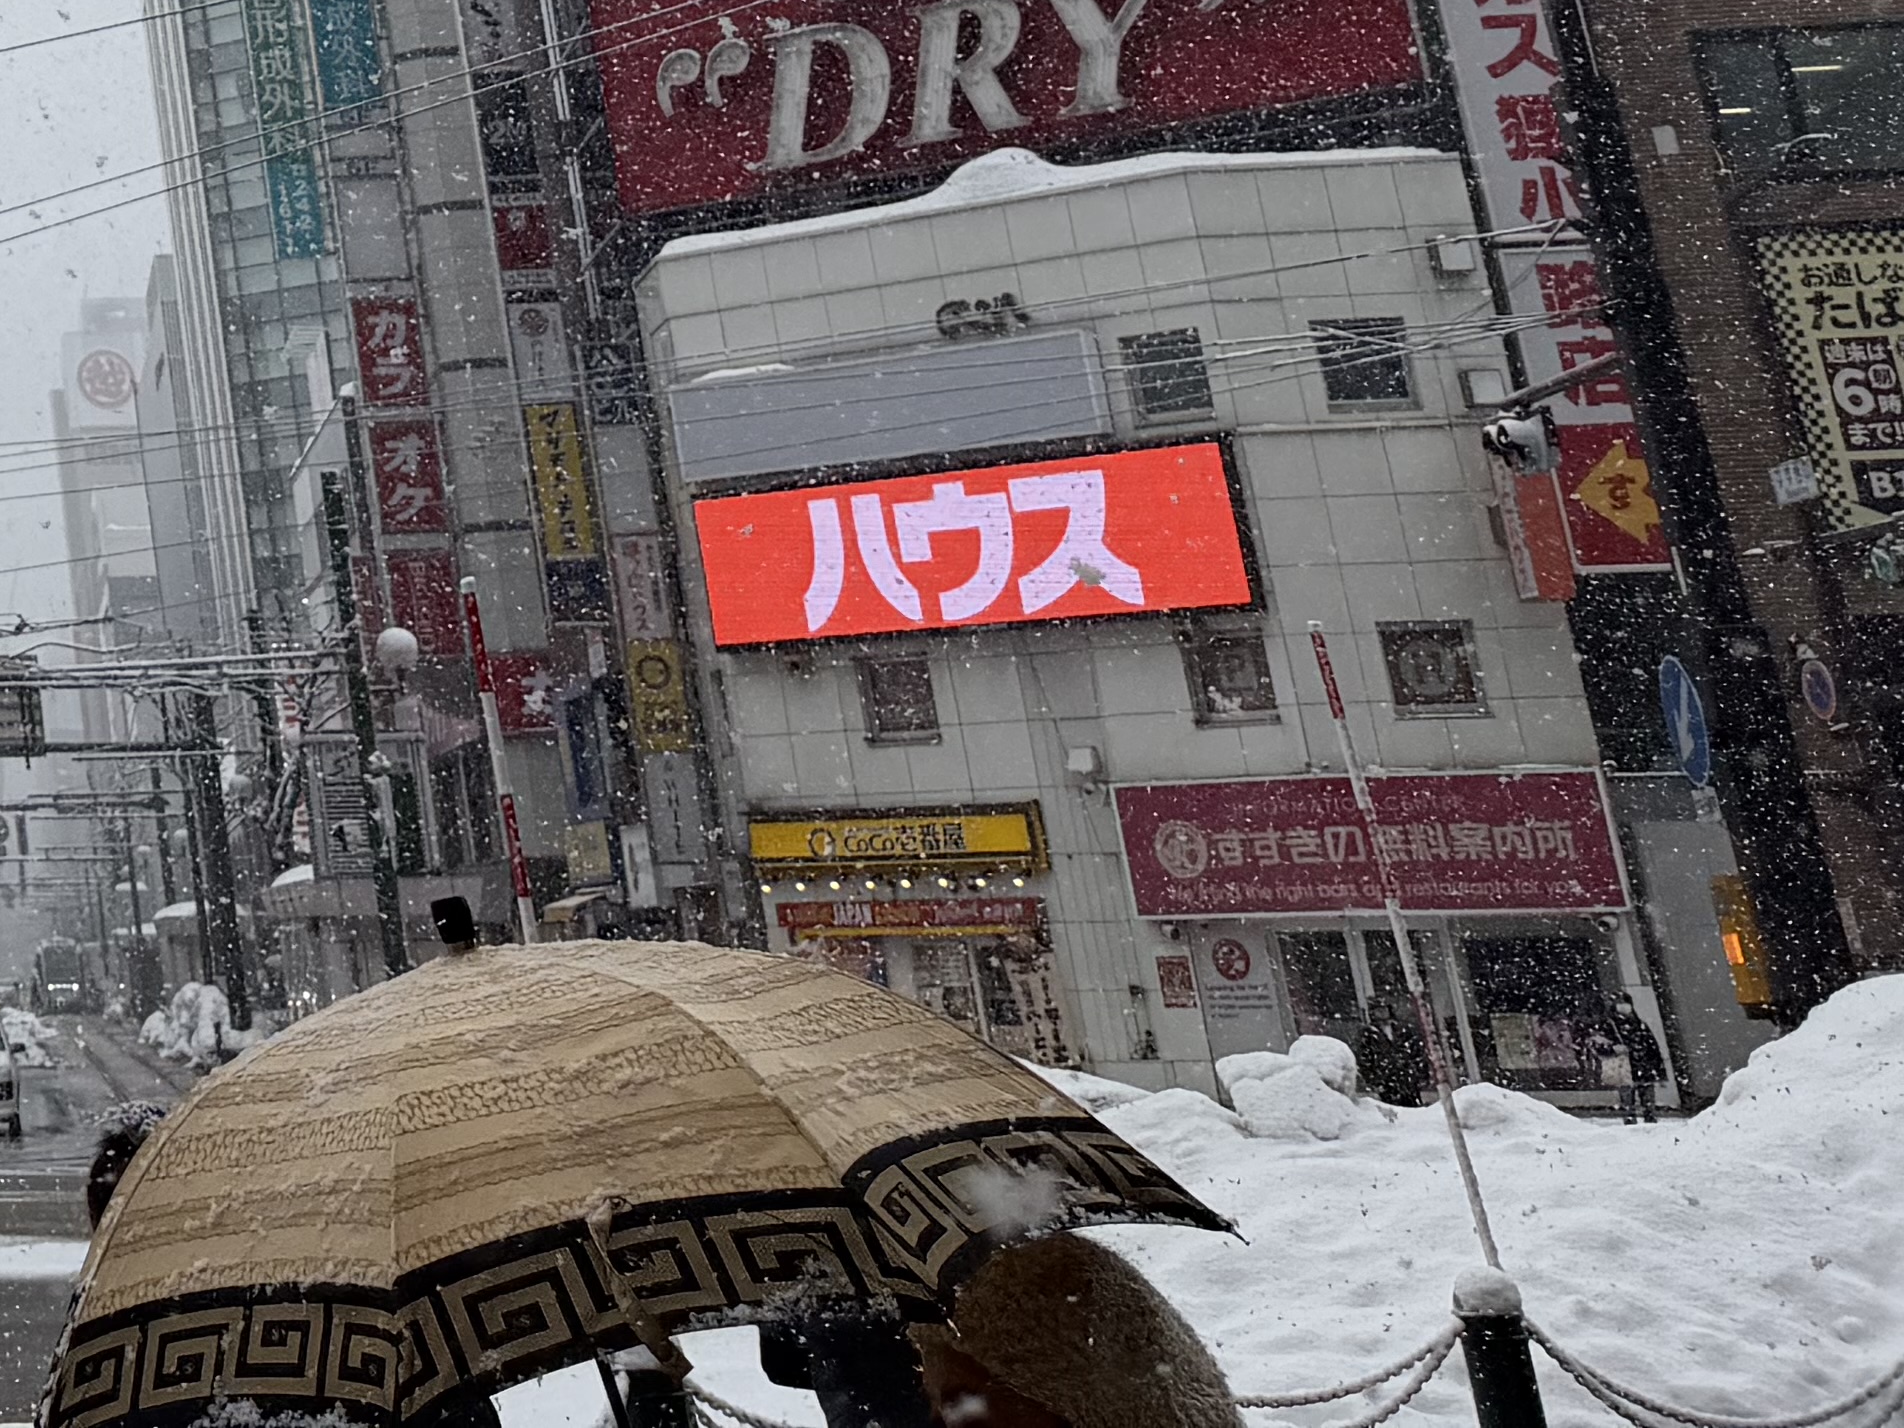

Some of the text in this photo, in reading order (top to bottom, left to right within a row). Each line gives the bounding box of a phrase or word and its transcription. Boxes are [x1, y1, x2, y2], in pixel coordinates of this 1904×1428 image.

[367, 306, 434, 523] カラオケ
[1832, 366, 1877, 417] 6
[802, 469, 1144, 633] ハウス
[843, 822, 966, 854] CoCo壱番屋
[1211, 819, 1576, 866] すすきの無料案内所
